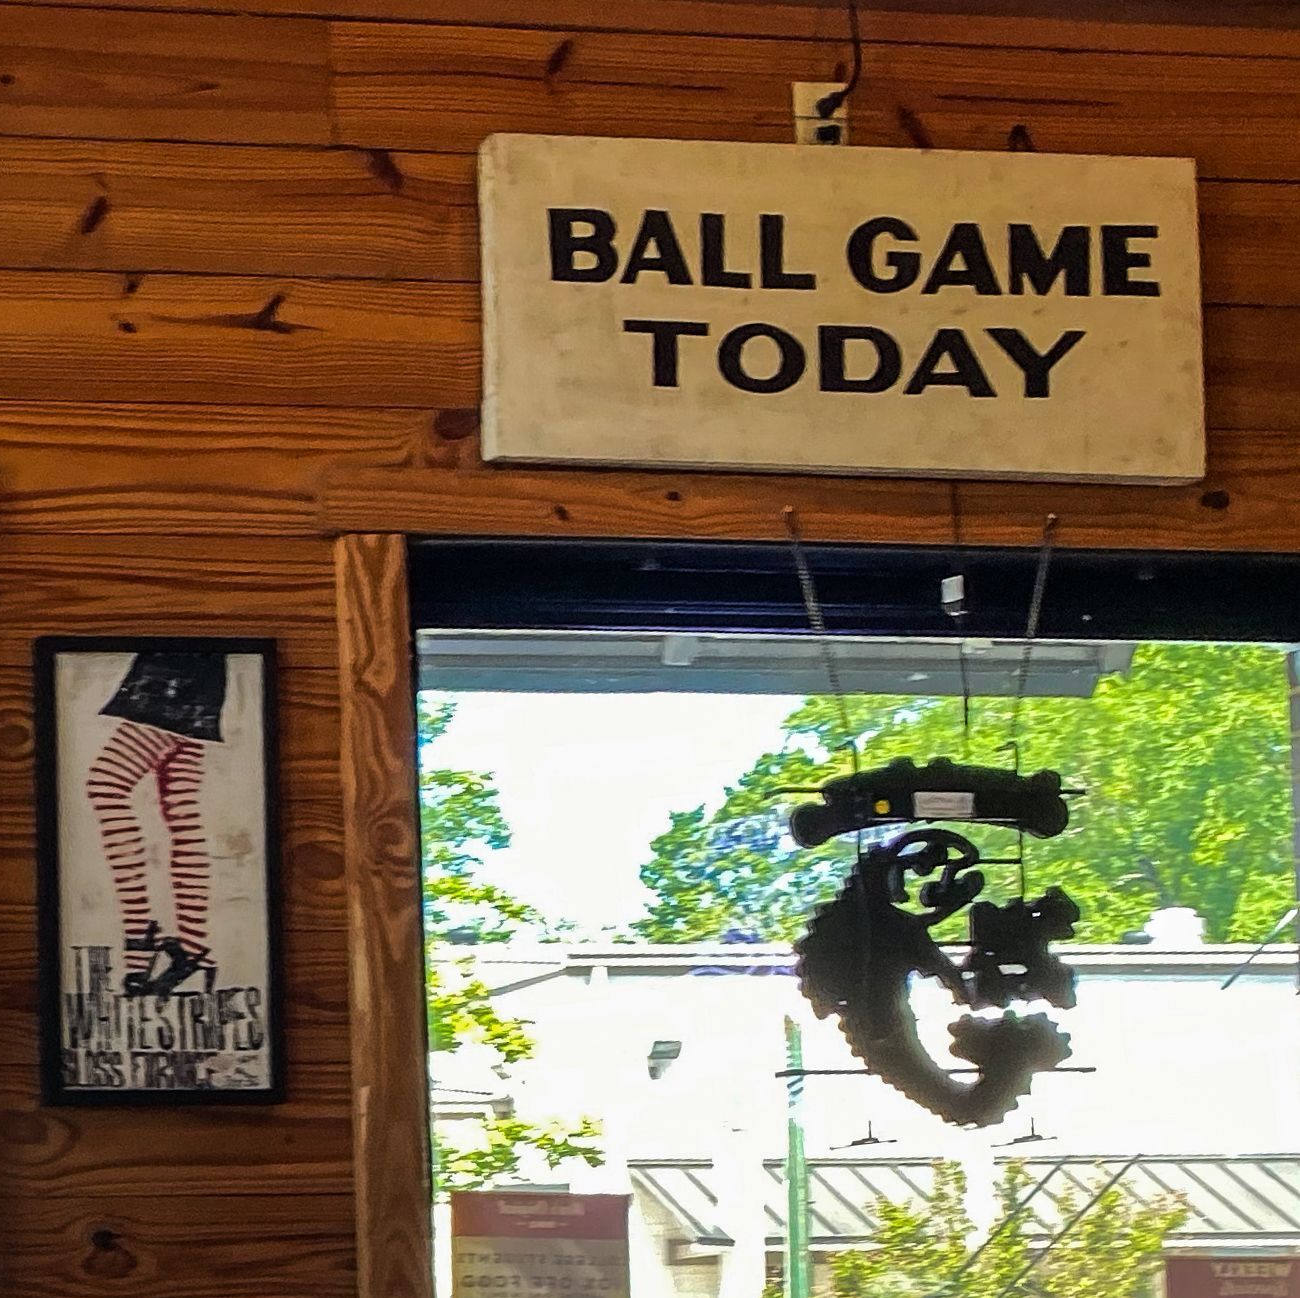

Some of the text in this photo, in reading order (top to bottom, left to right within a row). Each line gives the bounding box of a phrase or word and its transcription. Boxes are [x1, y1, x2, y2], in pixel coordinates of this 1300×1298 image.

[546, 207, 1162, 298] BALL GAME
[622, 318, 1086, 400] TODAY
